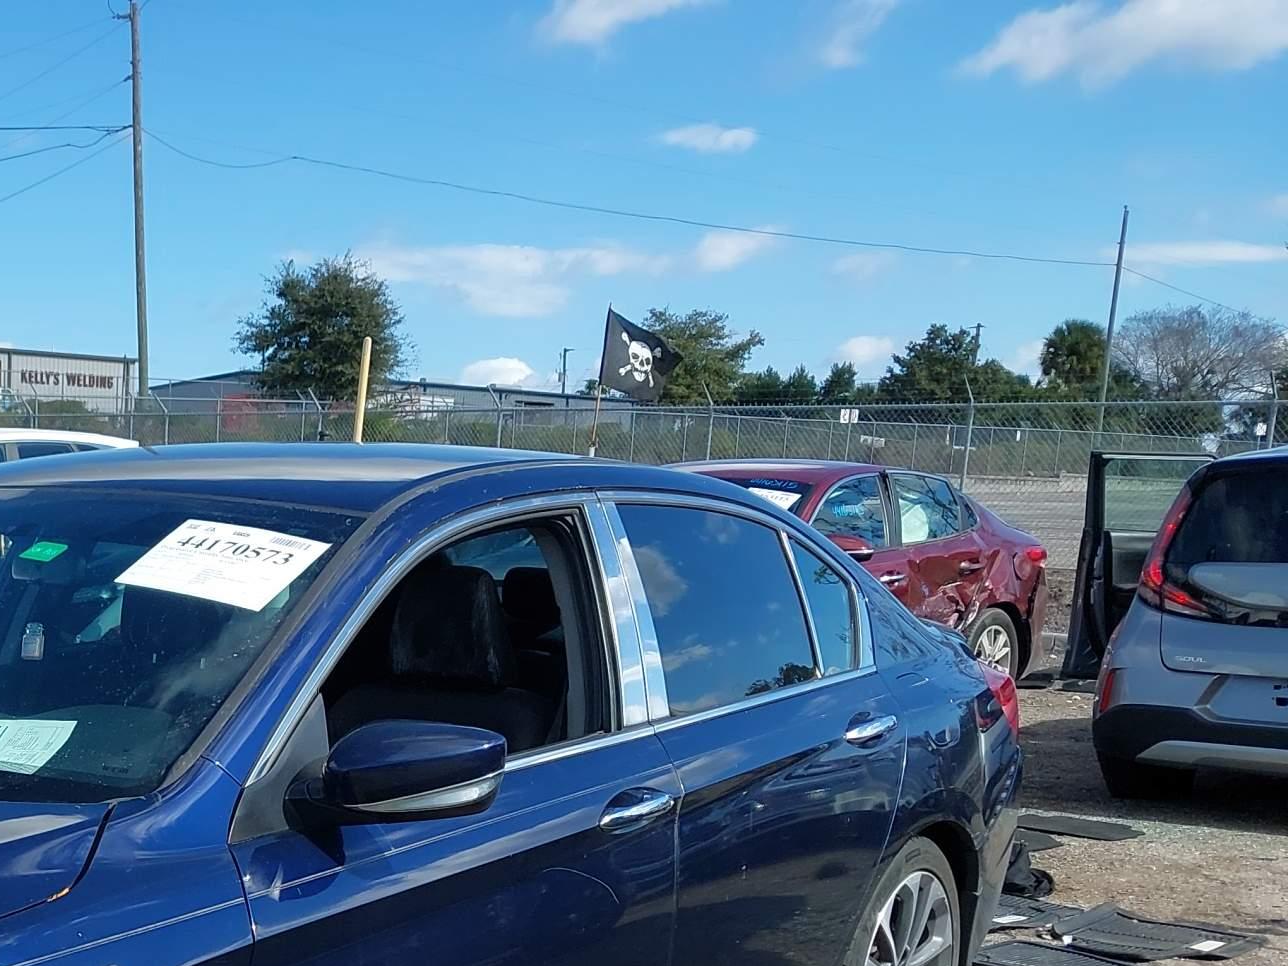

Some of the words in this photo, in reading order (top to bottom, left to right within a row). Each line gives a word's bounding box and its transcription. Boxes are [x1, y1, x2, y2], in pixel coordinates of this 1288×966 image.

[20, 369, 60, 386] KELLY'S
[66, 372, 114, 389] WELDING
[177, 535, 295, 566] 44170573
[1175, 655, 1207, 663] SOUL
